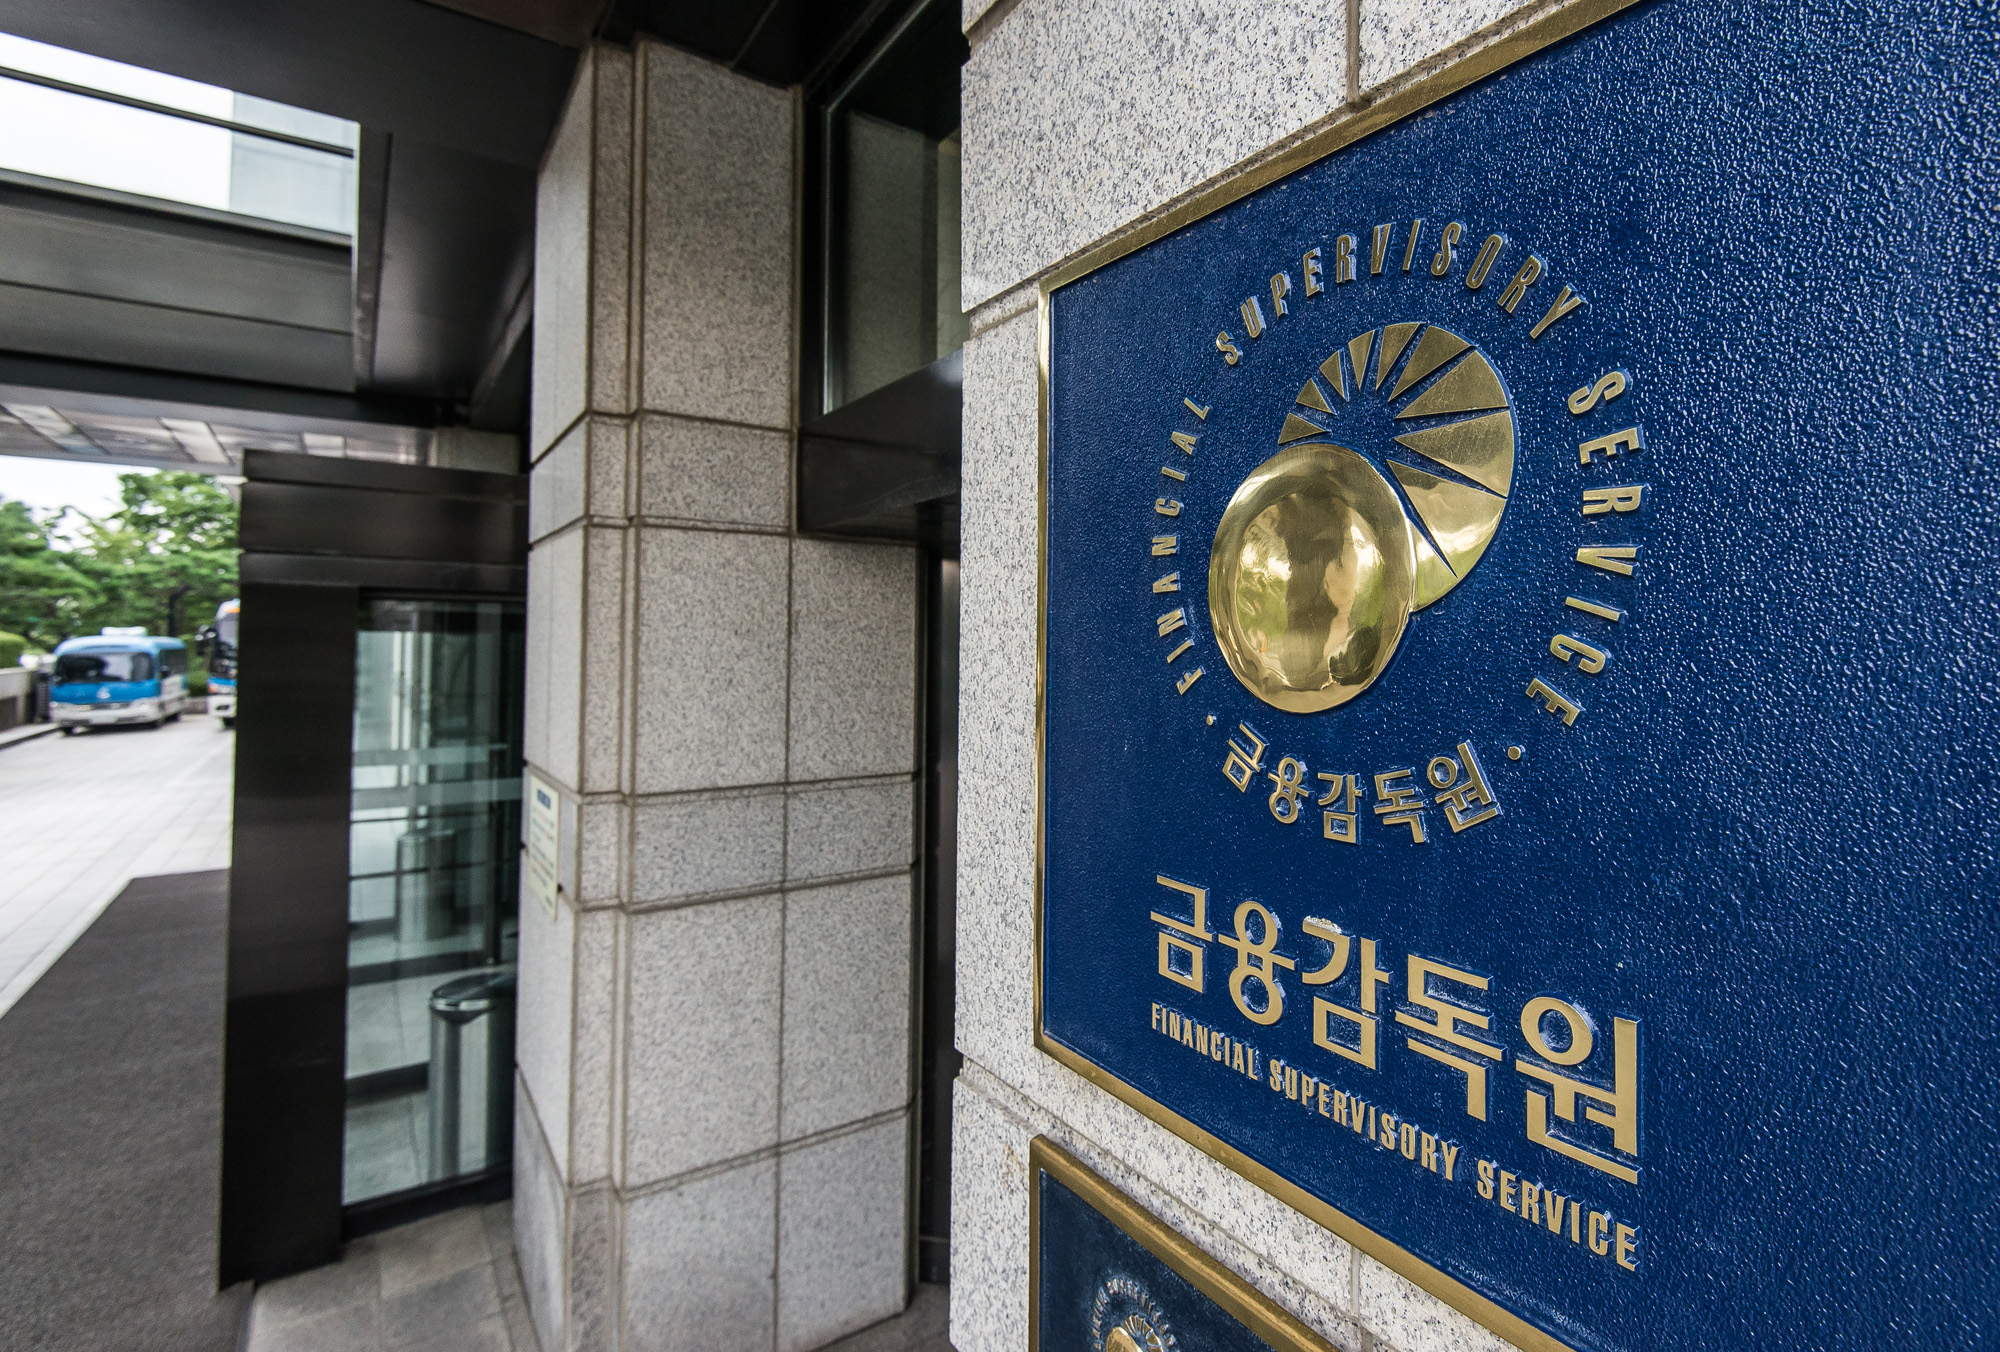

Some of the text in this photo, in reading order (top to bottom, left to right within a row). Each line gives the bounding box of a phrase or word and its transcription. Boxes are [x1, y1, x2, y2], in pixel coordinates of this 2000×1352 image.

[1151, 217, 1648, 727] FINANCIAL SUPERVISORY SERVICE
[1221, 723, 1502, 845] 금융감독원
[1150, 874, 1642, 1185] 금융감독원
[1151, 1002, 1641, 1272] FINANCIAL SUPERVISORY SERVICE
